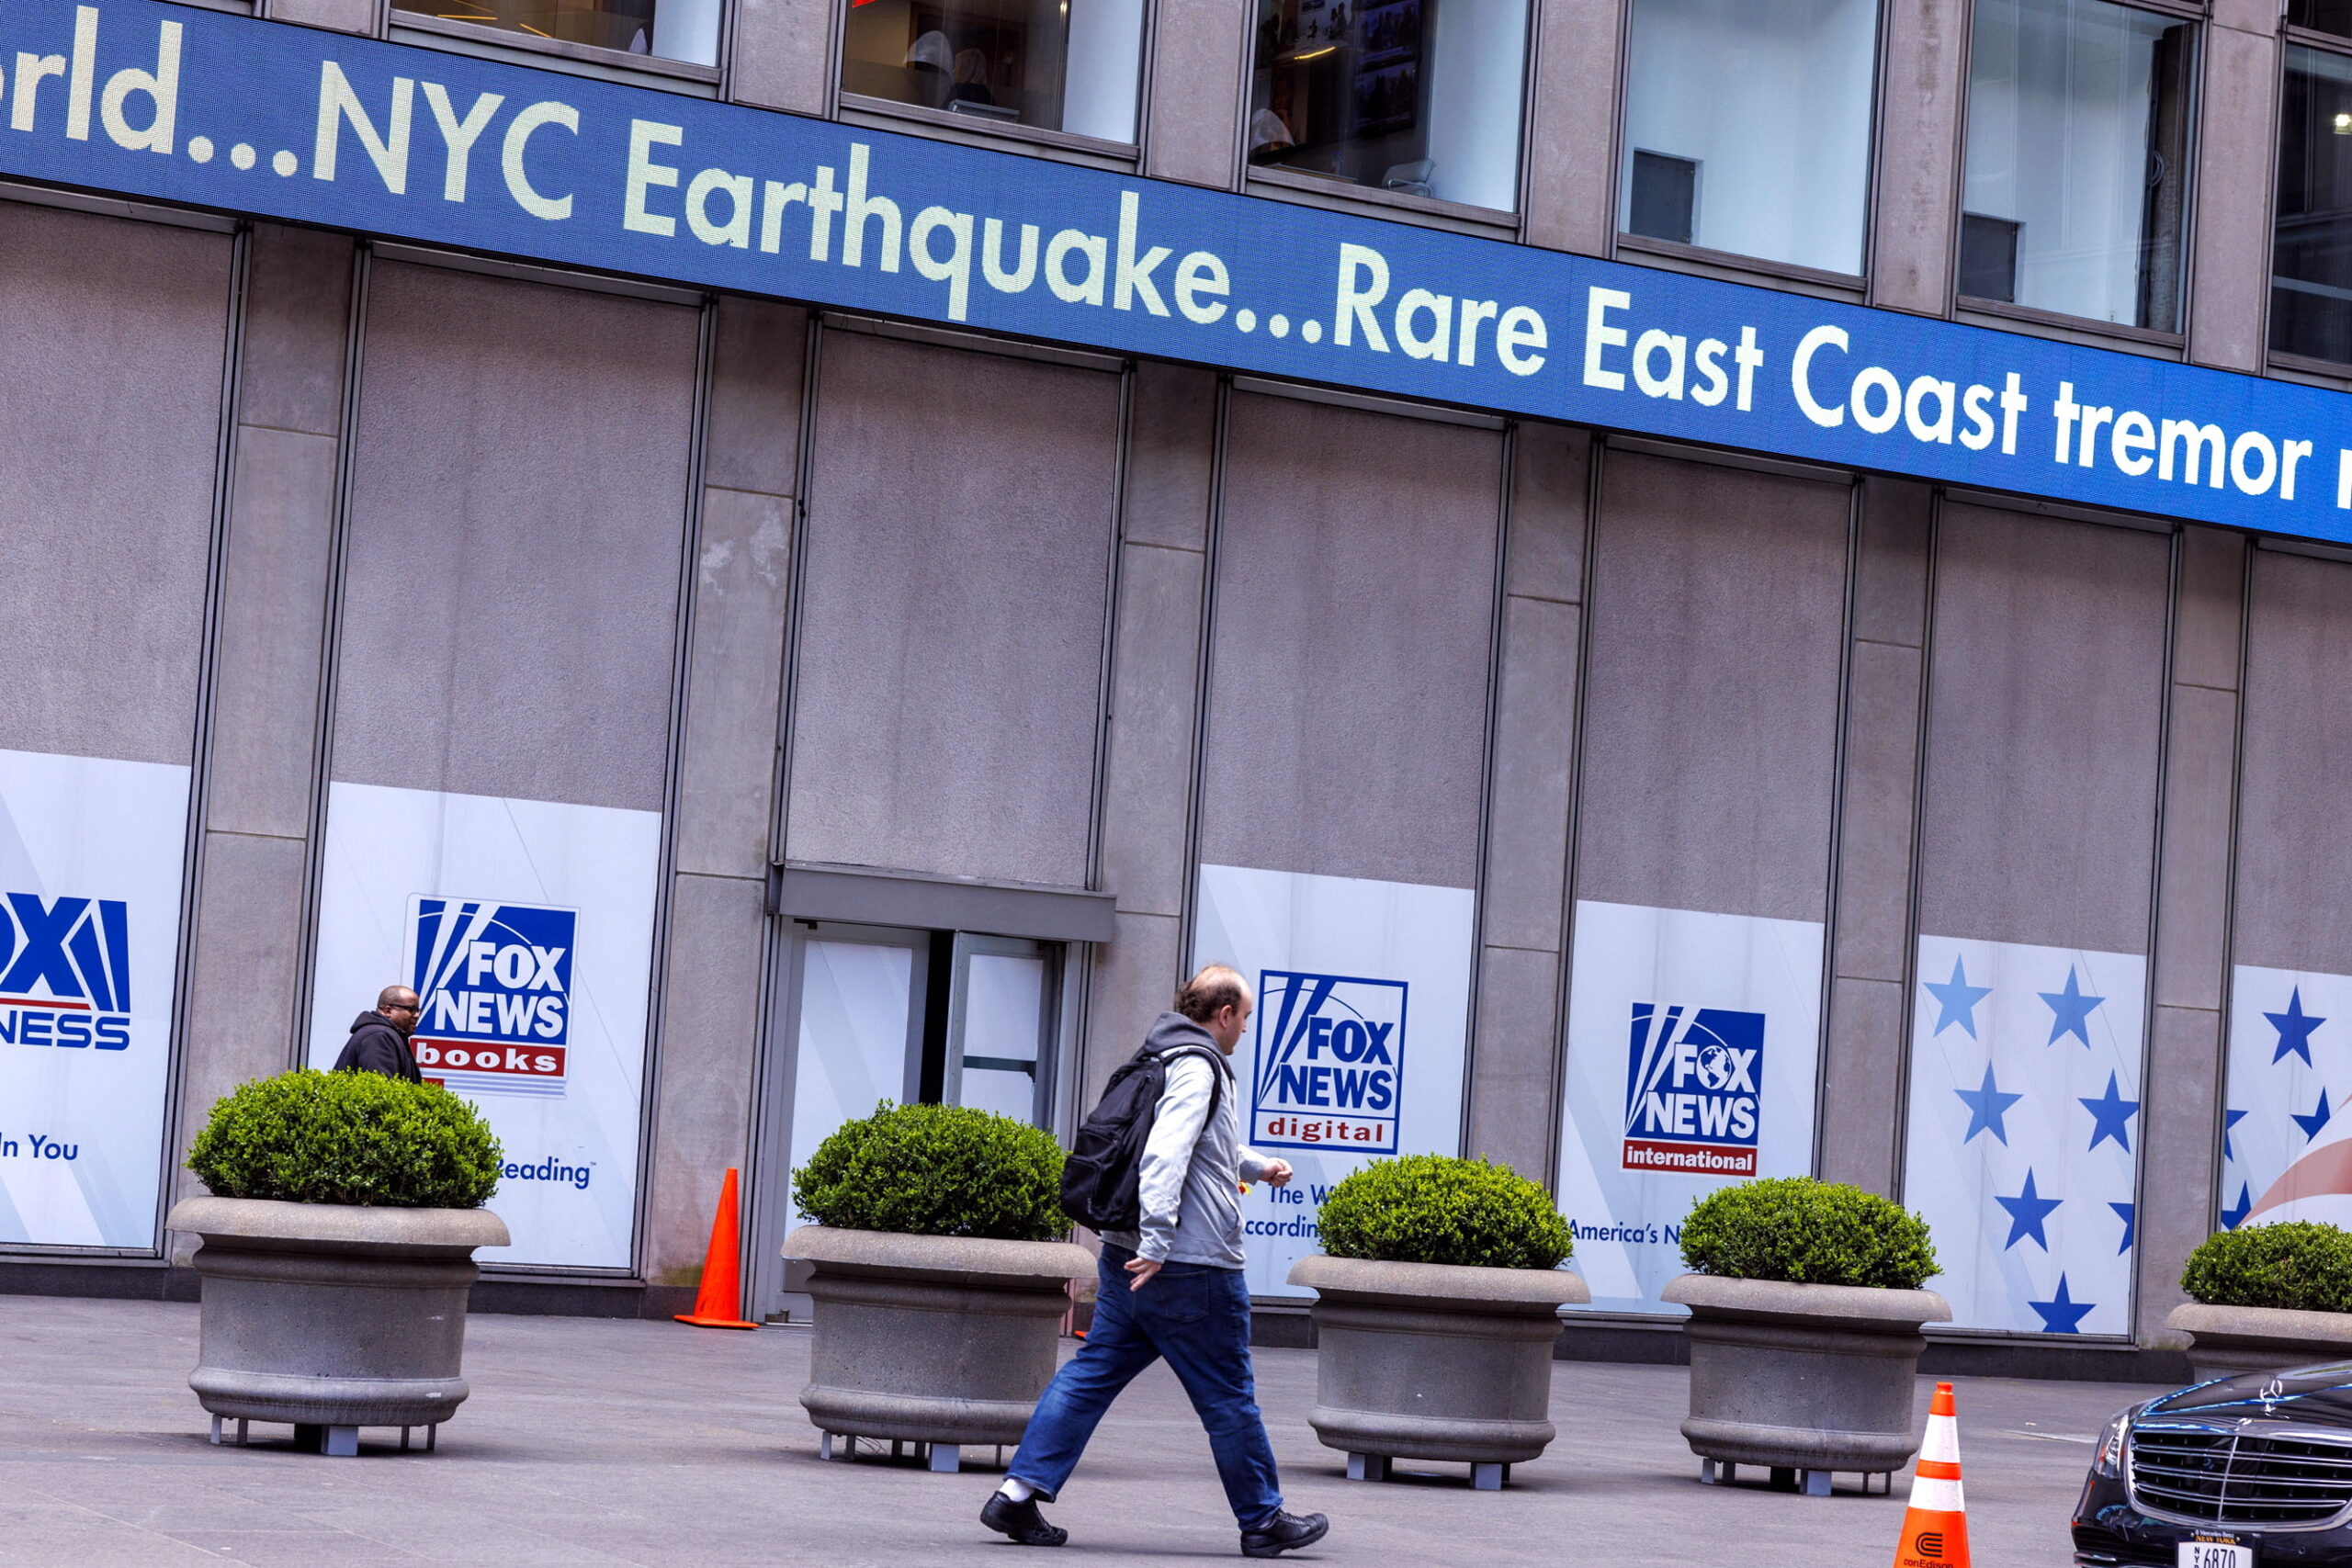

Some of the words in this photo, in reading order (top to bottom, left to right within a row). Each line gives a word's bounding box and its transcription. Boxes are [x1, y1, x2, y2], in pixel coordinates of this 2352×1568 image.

[0, 6, 579, 220] rld...NYC
[1583, 287, 1764, 412] East
[1792, 325, 2028, 455] Coast
[2054, 381, 2312, 501] tremor
[467, 940, 567, 992] FOX
[434, 988, 564, 1038] NEWS
[415, 1042, 557, 1072] books
[1306, 1016, 1395, 1066] FOX
[1278, 1064, 1393, 1111] NEWS
[1672, 1043, 1758, 1093] FOX
[1267, 1117, 1383, 1143] digital
[1645, 1091, 1756, 1139] NEWS
[28, 1134, 78, 1160] You
[1626, 1145, 1753, 1171] international
[1242, 1214, 1323, 1243] ccordin
[2204, 1548, 2236, 1568] 6870
